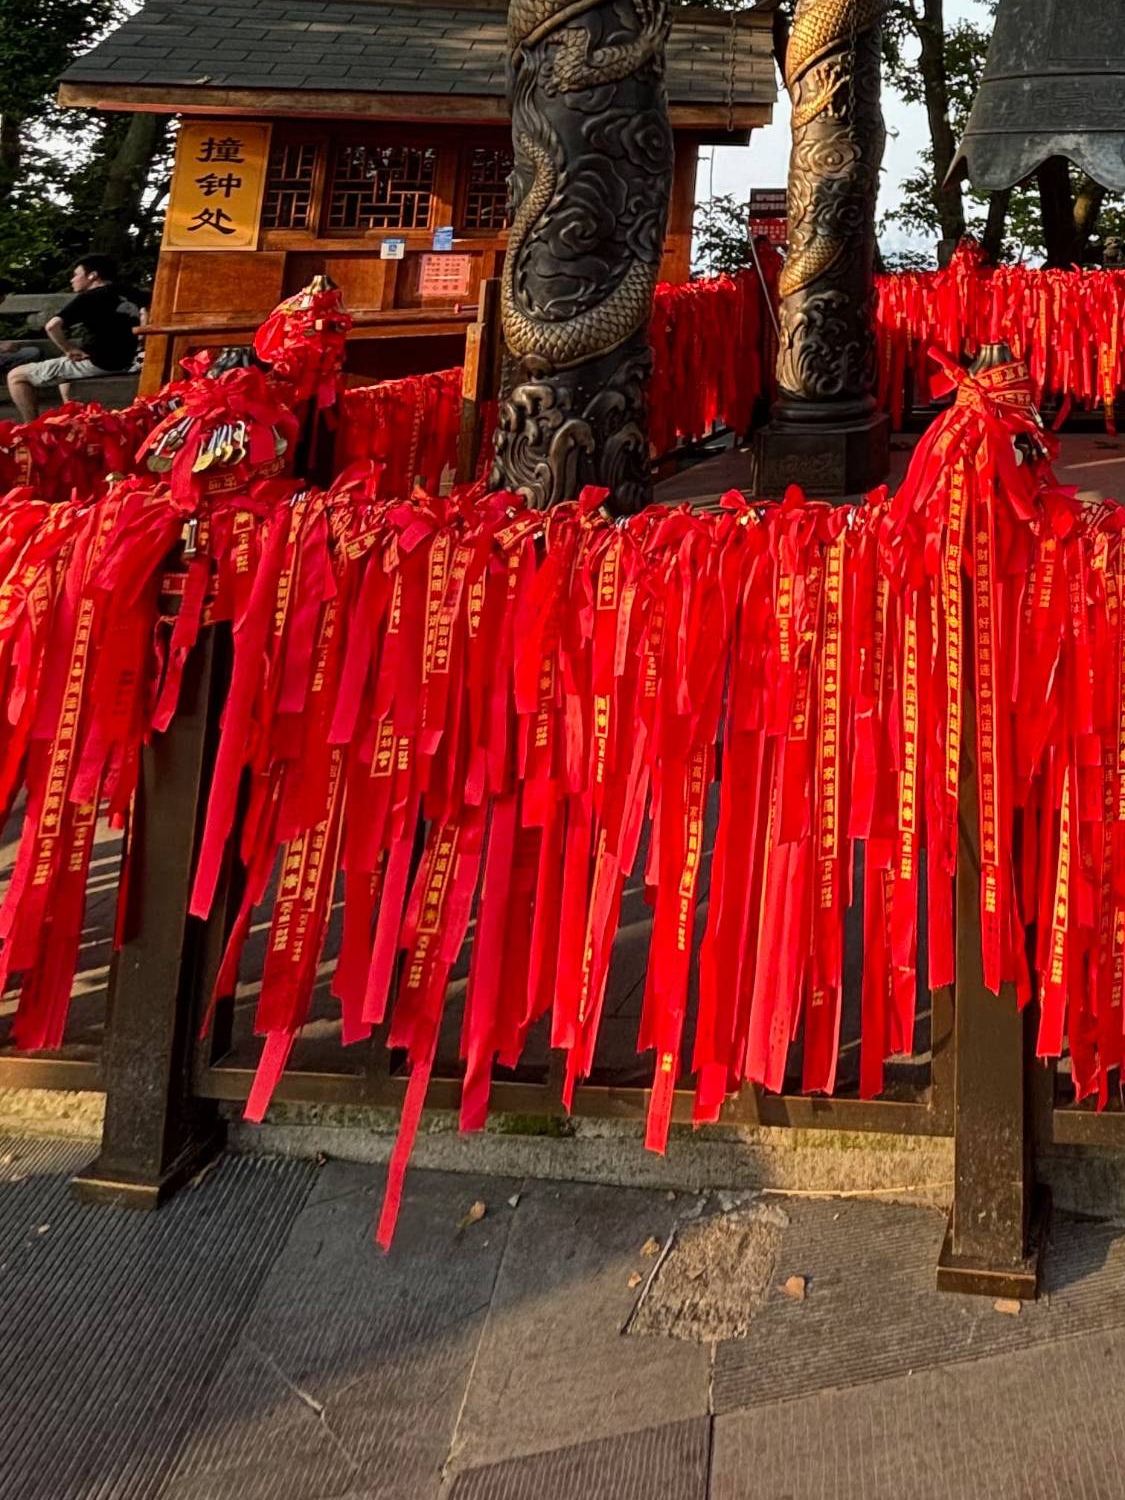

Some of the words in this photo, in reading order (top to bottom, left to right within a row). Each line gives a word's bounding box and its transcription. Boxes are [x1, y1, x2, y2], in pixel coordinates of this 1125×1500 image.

[187, 137, 245, 235] 撞钟处
[978, 617, 992, 677] 好运连连
